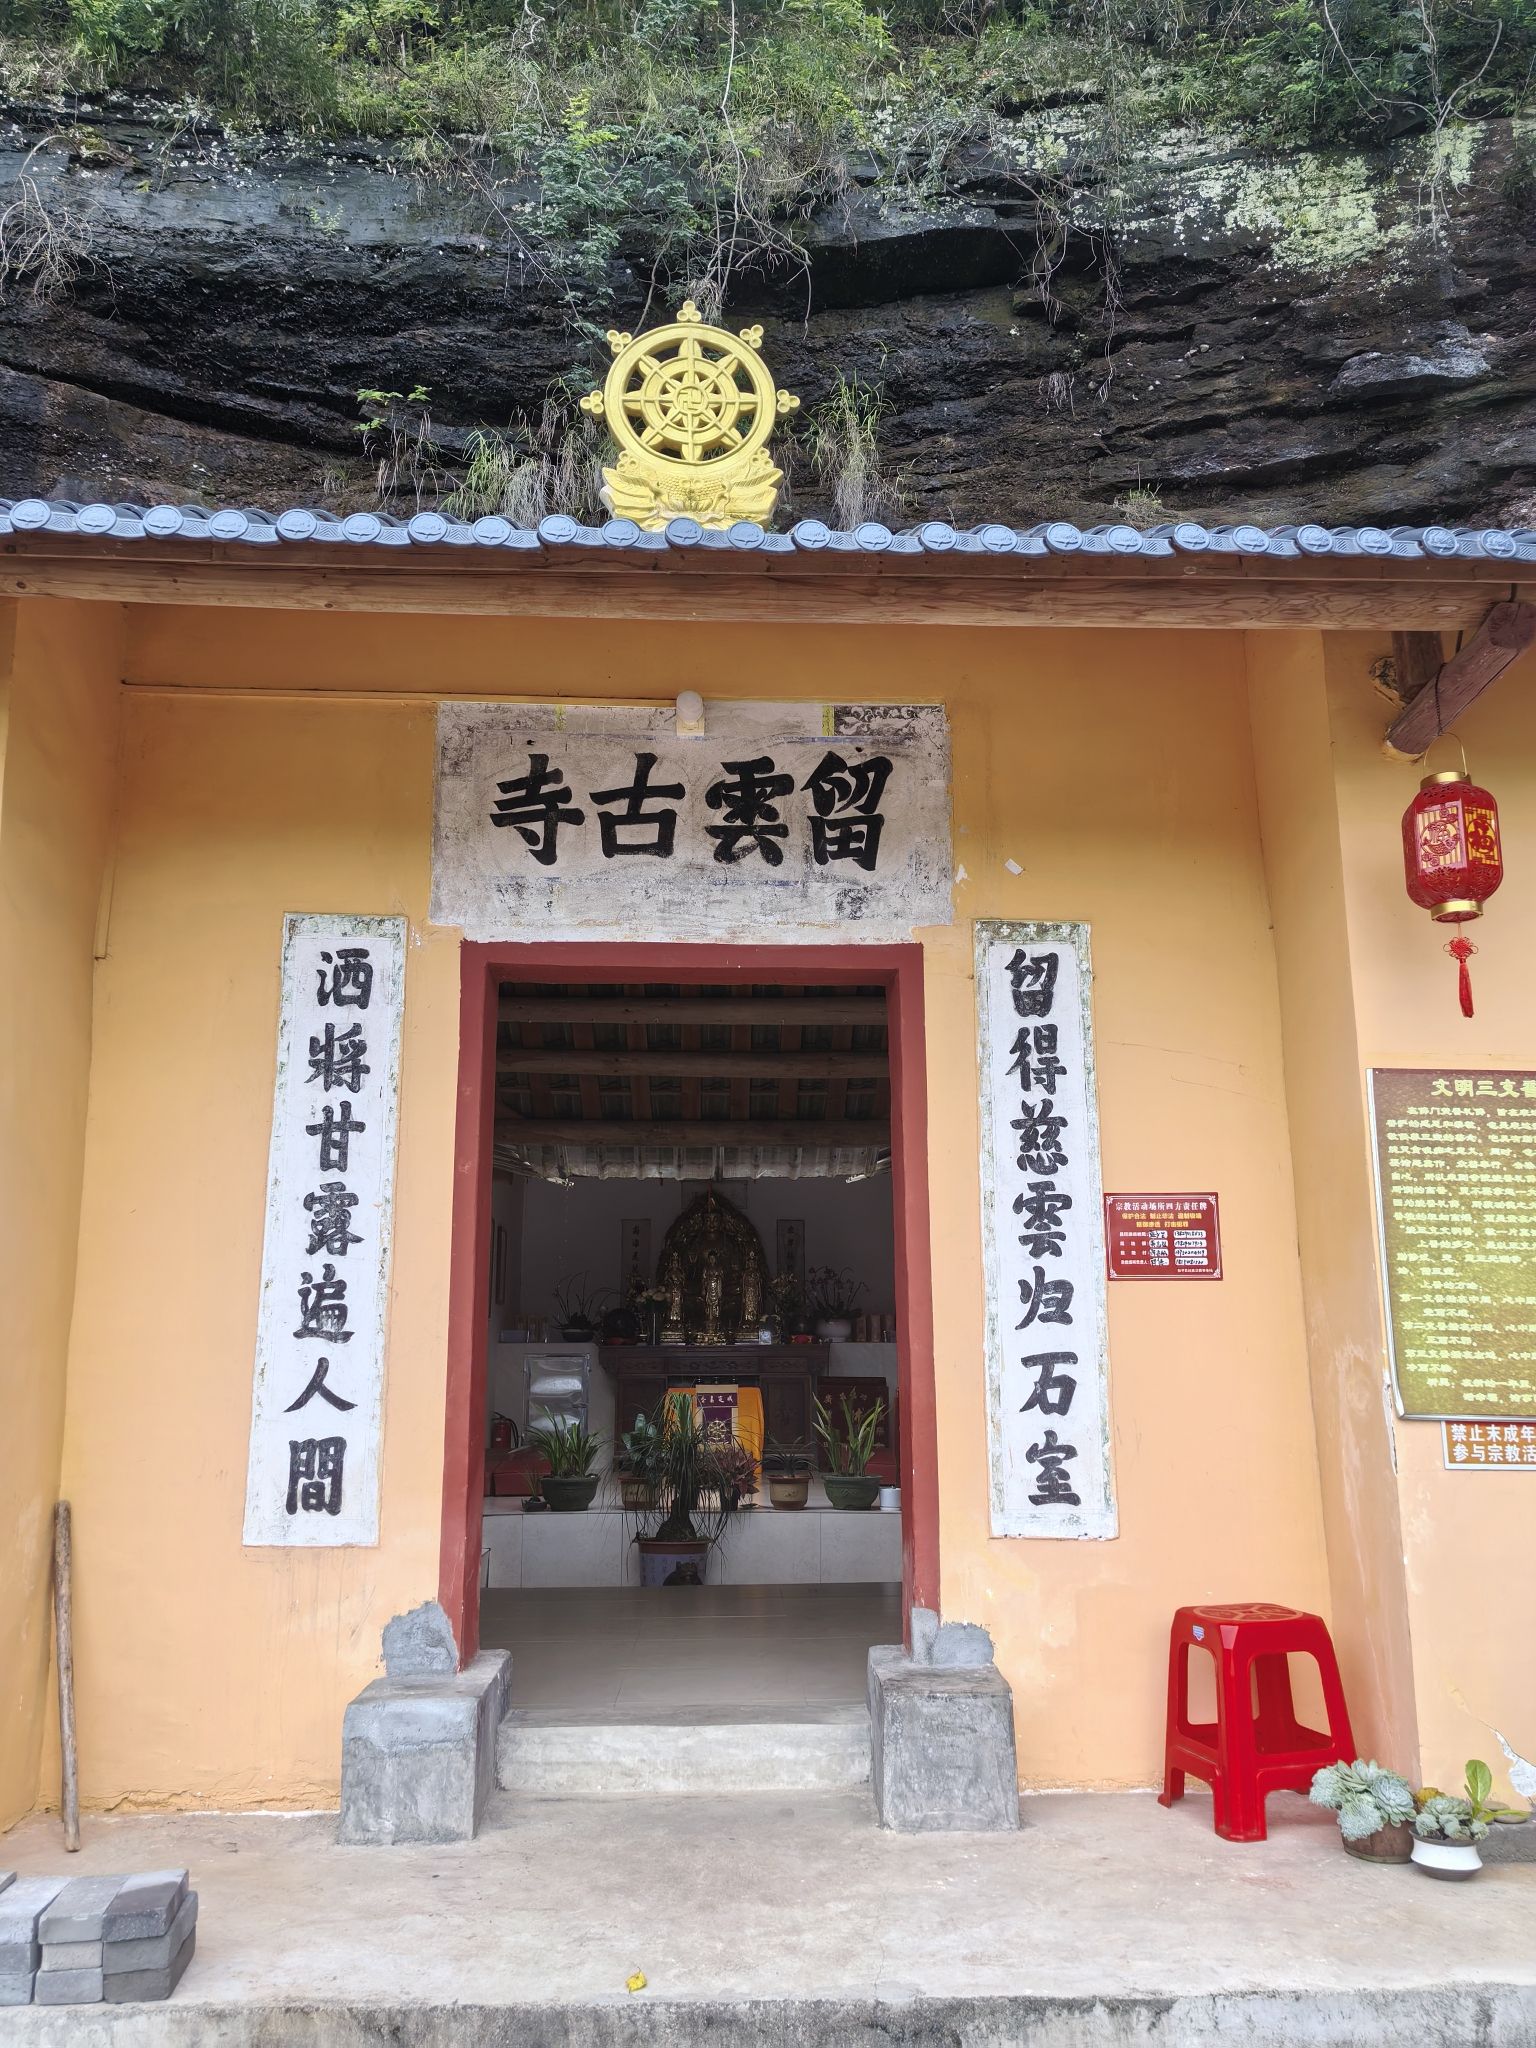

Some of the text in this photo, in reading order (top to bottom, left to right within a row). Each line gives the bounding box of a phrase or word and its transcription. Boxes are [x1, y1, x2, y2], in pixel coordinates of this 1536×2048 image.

[1452, 1442, 1536, 1462] 参与宗教活
